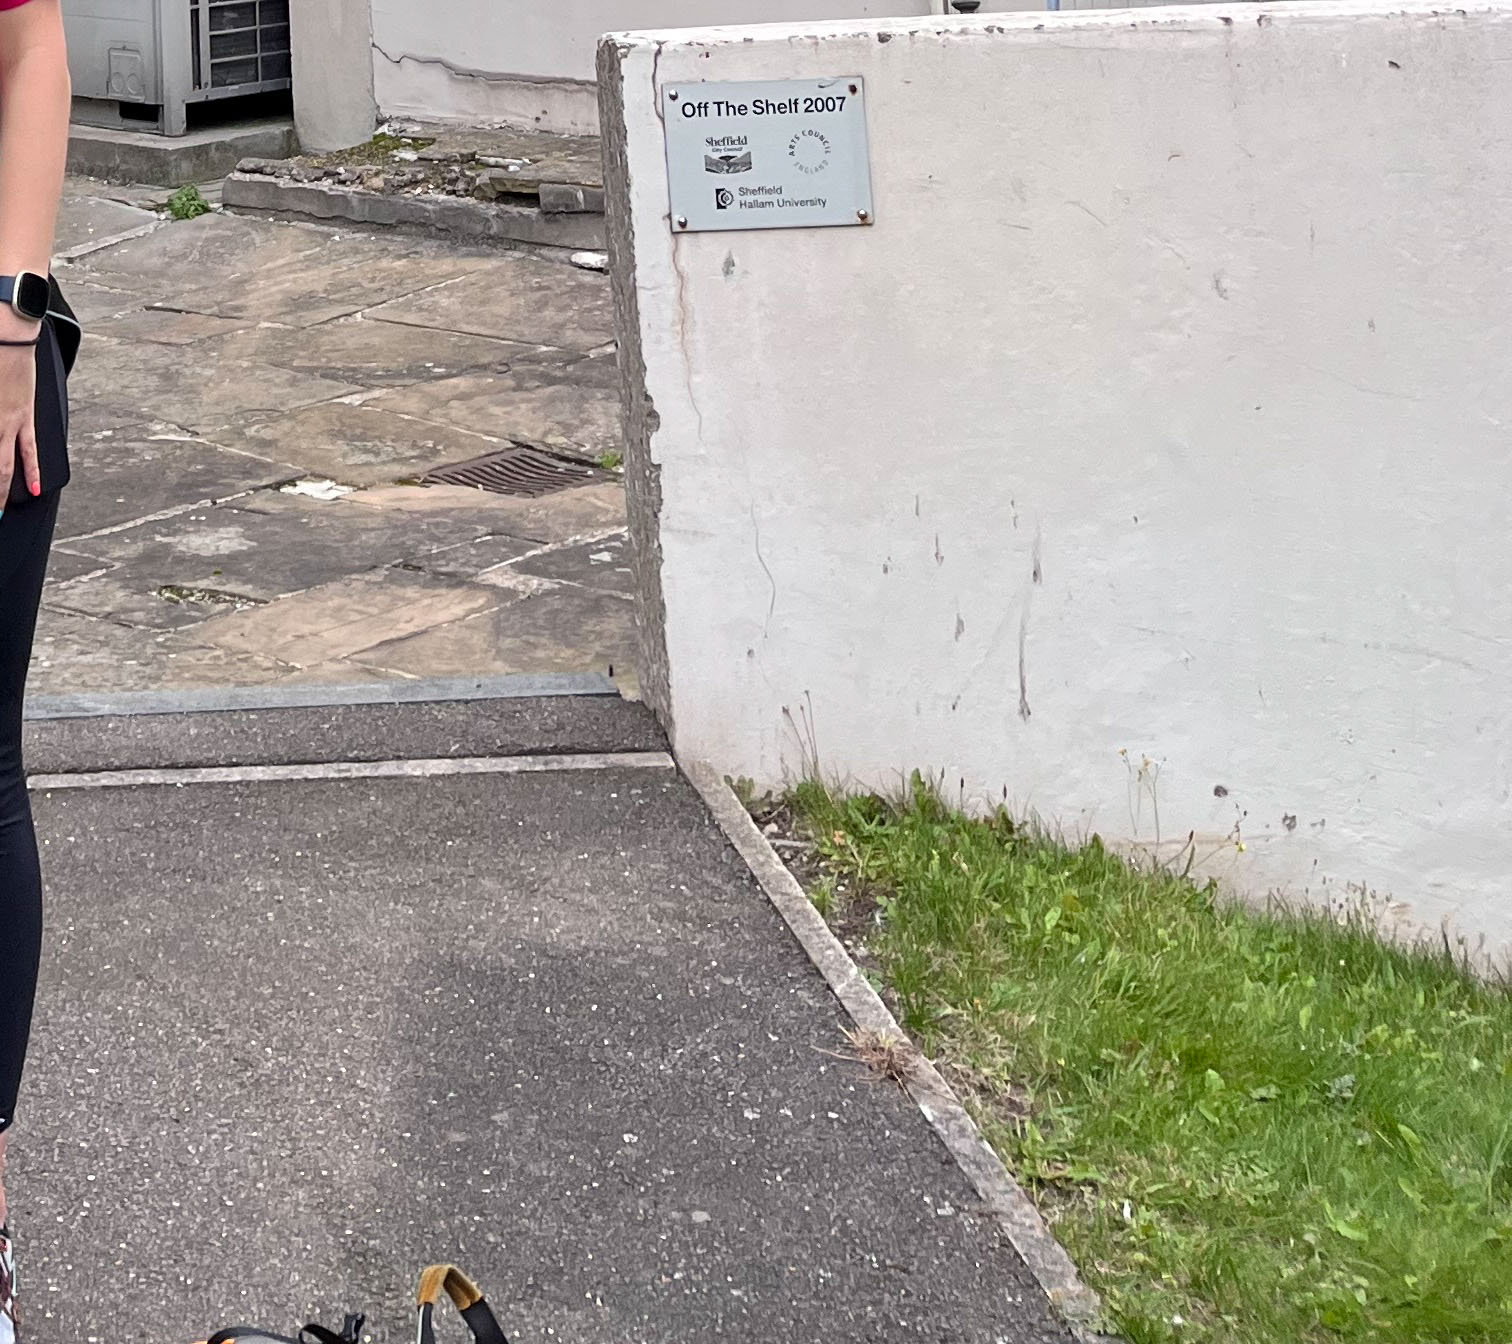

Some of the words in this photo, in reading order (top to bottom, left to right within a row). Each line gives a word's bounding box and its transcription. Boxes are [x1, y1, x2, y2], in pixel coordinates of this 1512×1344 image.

[681, 102, 709, 118] Off
[714, 101, 748, 116] The
[753, 98, 799, 115] Shelf
[803, 96, 846, 113] 2007
[705, 136, 747, 147] Sheffield
[738, 186, 782, 196] Sheffield
[739, 199, 774, 209] Hallam
[777, 197, 827, 208] University
